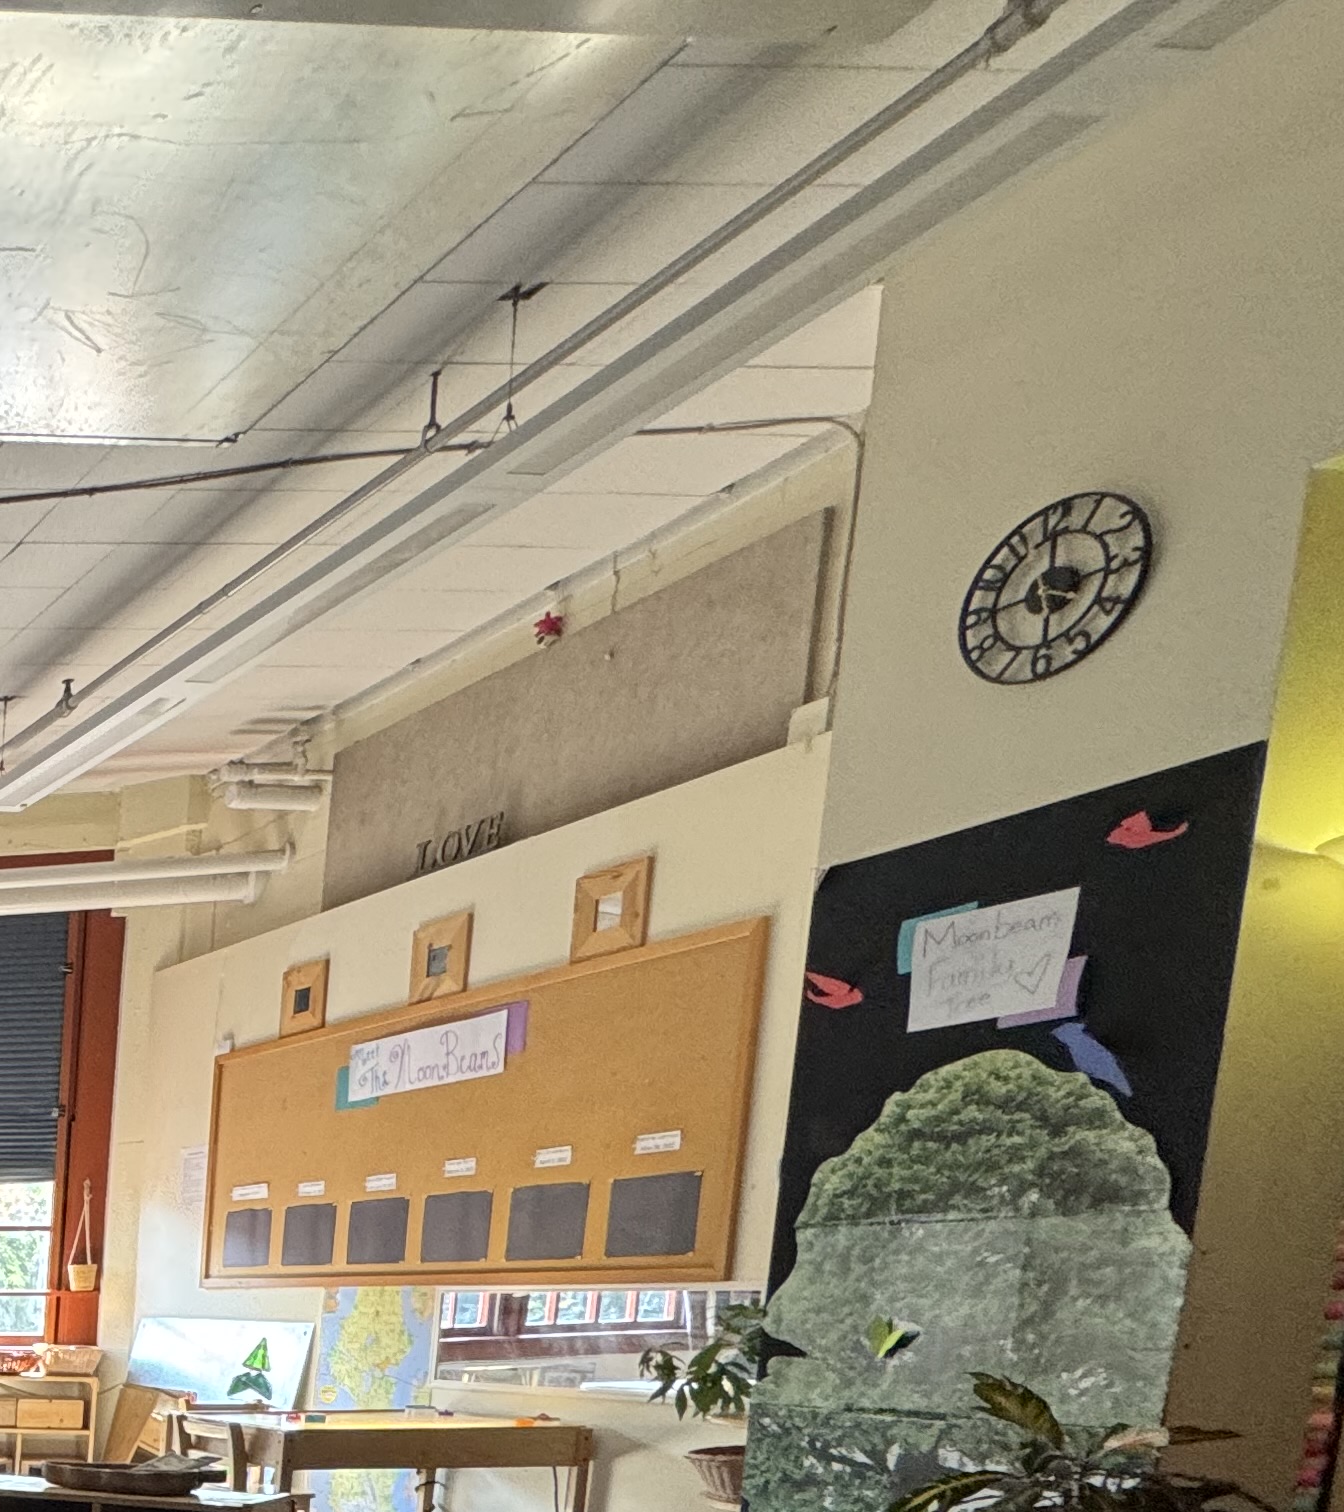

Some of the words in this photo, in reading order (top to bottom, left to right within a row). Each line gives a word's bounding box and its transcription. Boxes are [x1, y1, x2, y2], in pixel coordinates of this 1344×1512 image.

[1033, 499, 1074, 550] 12
[1097, 508, 1139, 538] 2
[1108, 545, 1150, 577] 3
[974, 563, 1010, 592] 10
[964, 606, 995, 632] 9
[1096, 595, 1134, 618] 4
[968, 634, 999, 665] 8
[1062, 629, 1093, 656] 5
[1030, 644, 1054, 678] 6
[415, 811, 504, 872] LOVE
[926, 952, 1017, 998] Family
[940, 990, 992, 1019] Tree
